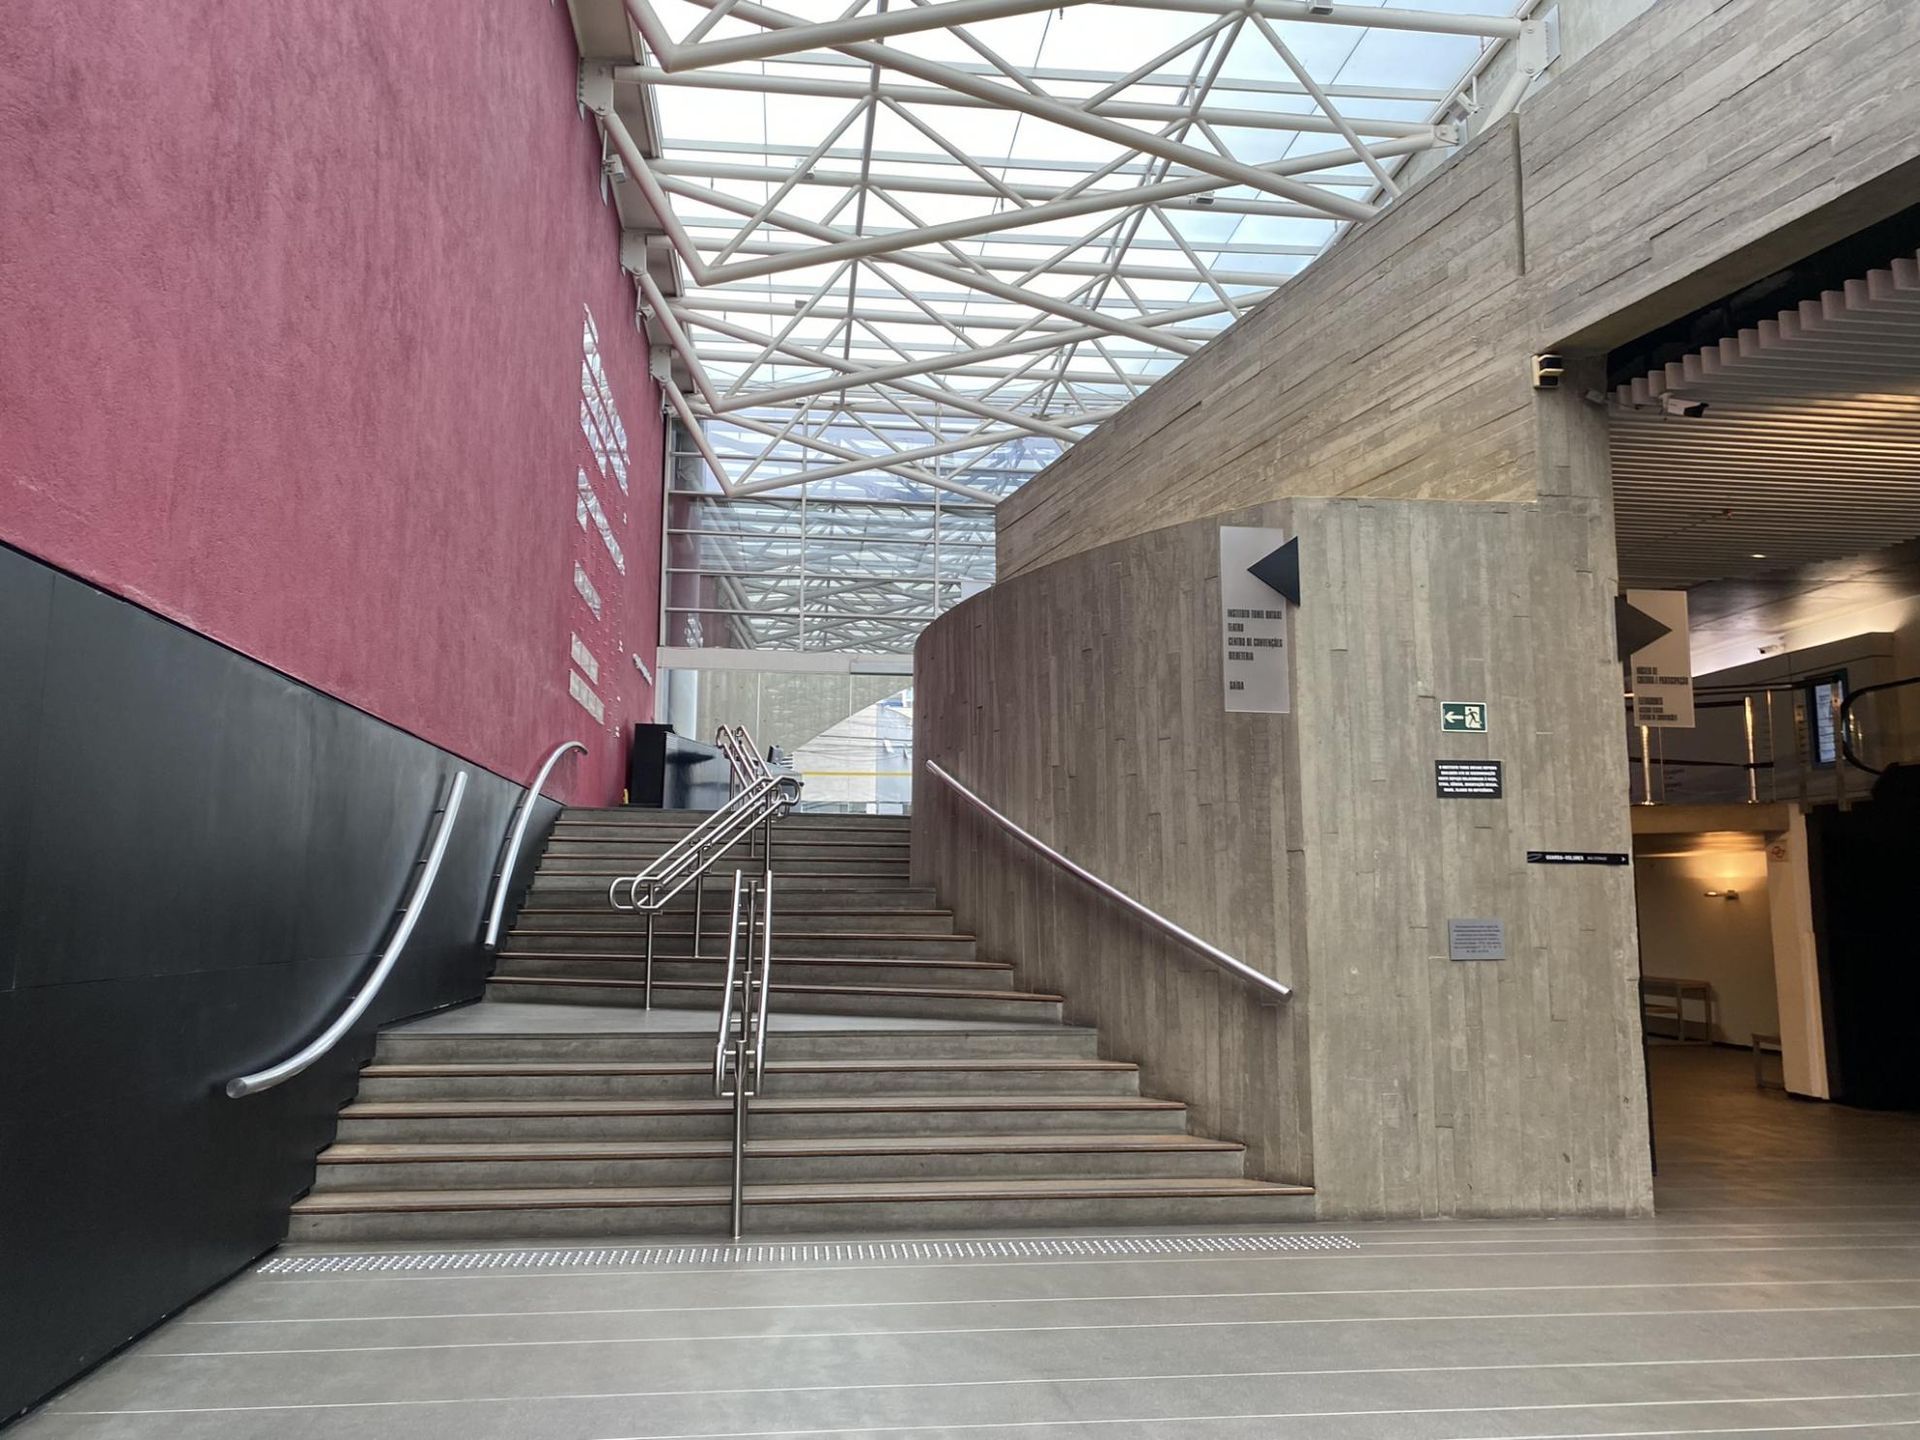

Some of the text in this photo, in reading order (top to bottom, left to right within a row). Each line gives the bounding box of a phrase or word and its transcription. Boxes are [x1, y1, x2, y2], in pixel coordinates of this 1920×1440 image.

[1228, 622, 1244, 632] TEATRO
[1228, 637, 1283, 649] CENTRO DE CONVENÇÕES
